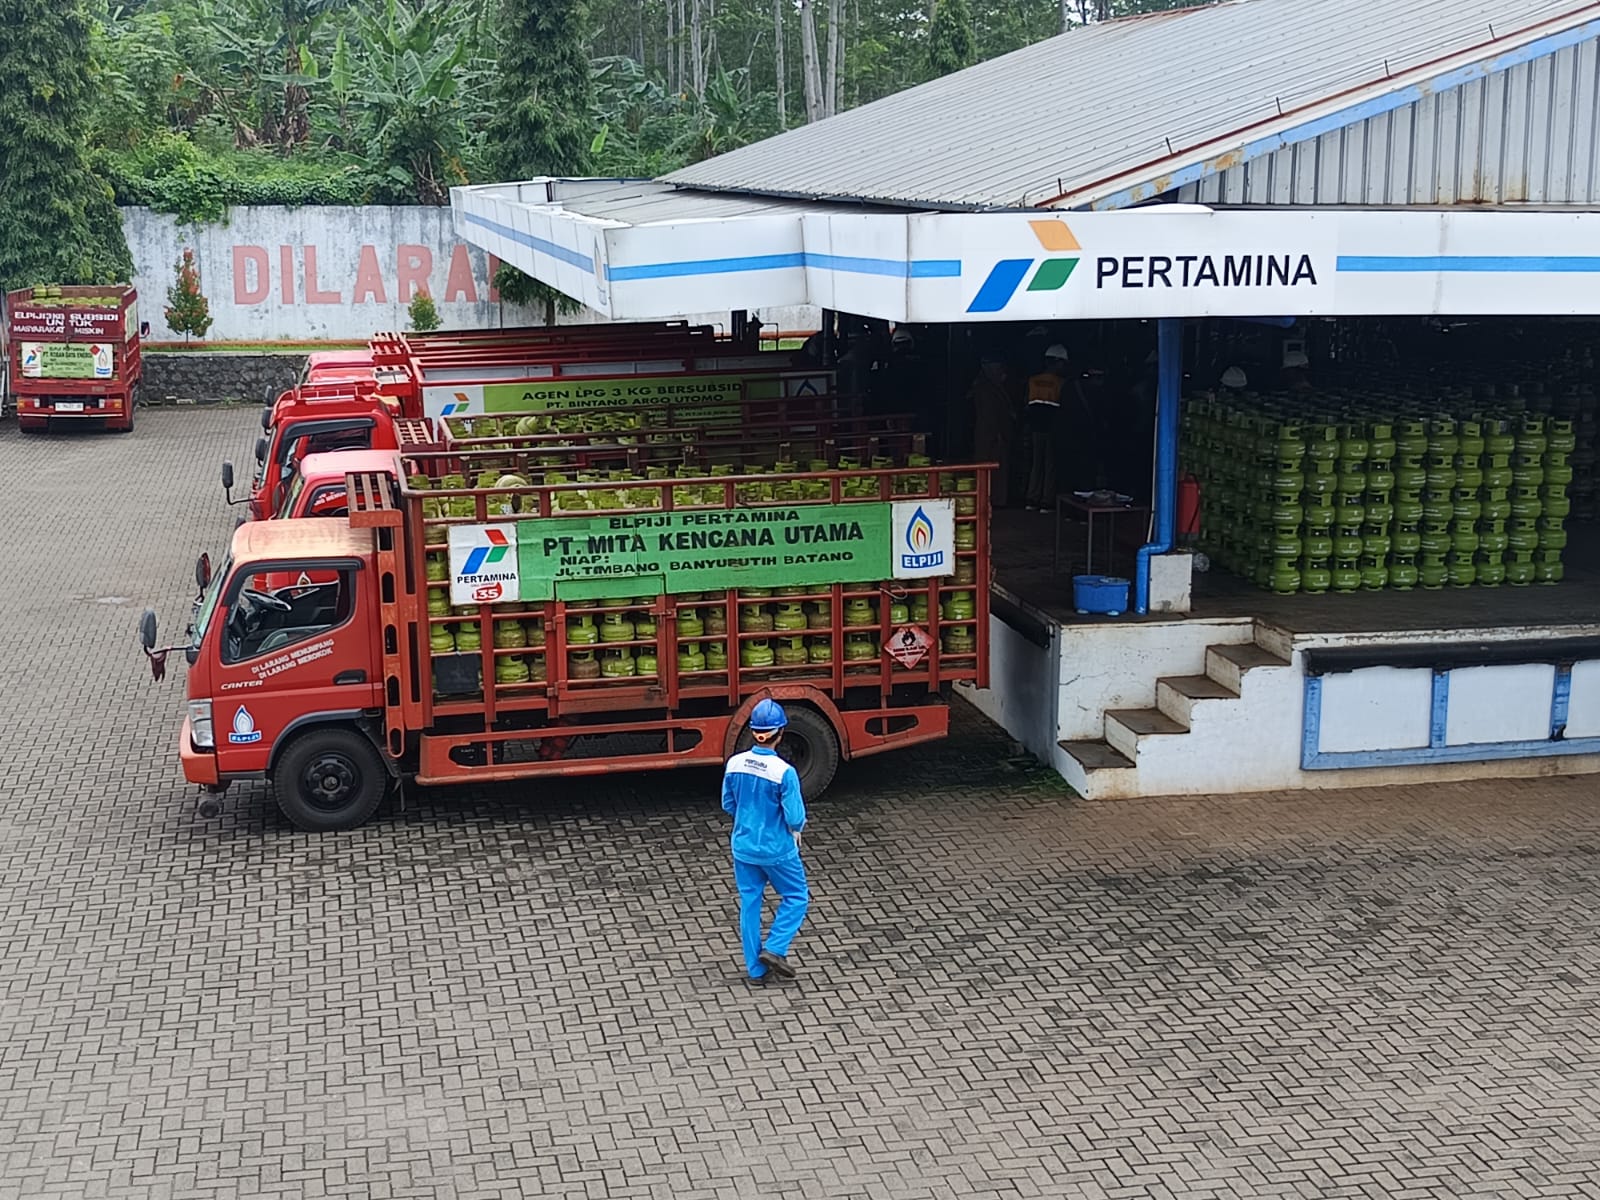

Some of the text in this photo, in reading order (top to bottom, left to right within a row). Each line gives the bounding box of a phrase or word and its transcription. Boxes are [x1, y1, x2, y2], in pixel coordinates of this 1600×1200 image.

[1096, 254, 1317, 289] PERTAMINA
[522, 383, 742, 400] AGEN LPG 3 KG BERSUBSID
[546, 394, 724, 409] PT. BINTANG ARGO UTOMO
[609, 510, 800, 529] ELPIJI PERTAMINA
[659, 527, 775, 551] KENCANA
[784, 521, 864, 544] UTAMA
[560, 555, 610, 565] NIAP:
[784, 552, 854, 565] BATANG
[903, 552, 943, 567] ELPIJI
[457, 572, 517, 584] PERTAMINA
[473, 588, 499, 600] 135
[260, 655, 290, 671] LARANG
[266, 661, 297, 677] LARANG
[220, 680, 263, 690] CANTER
